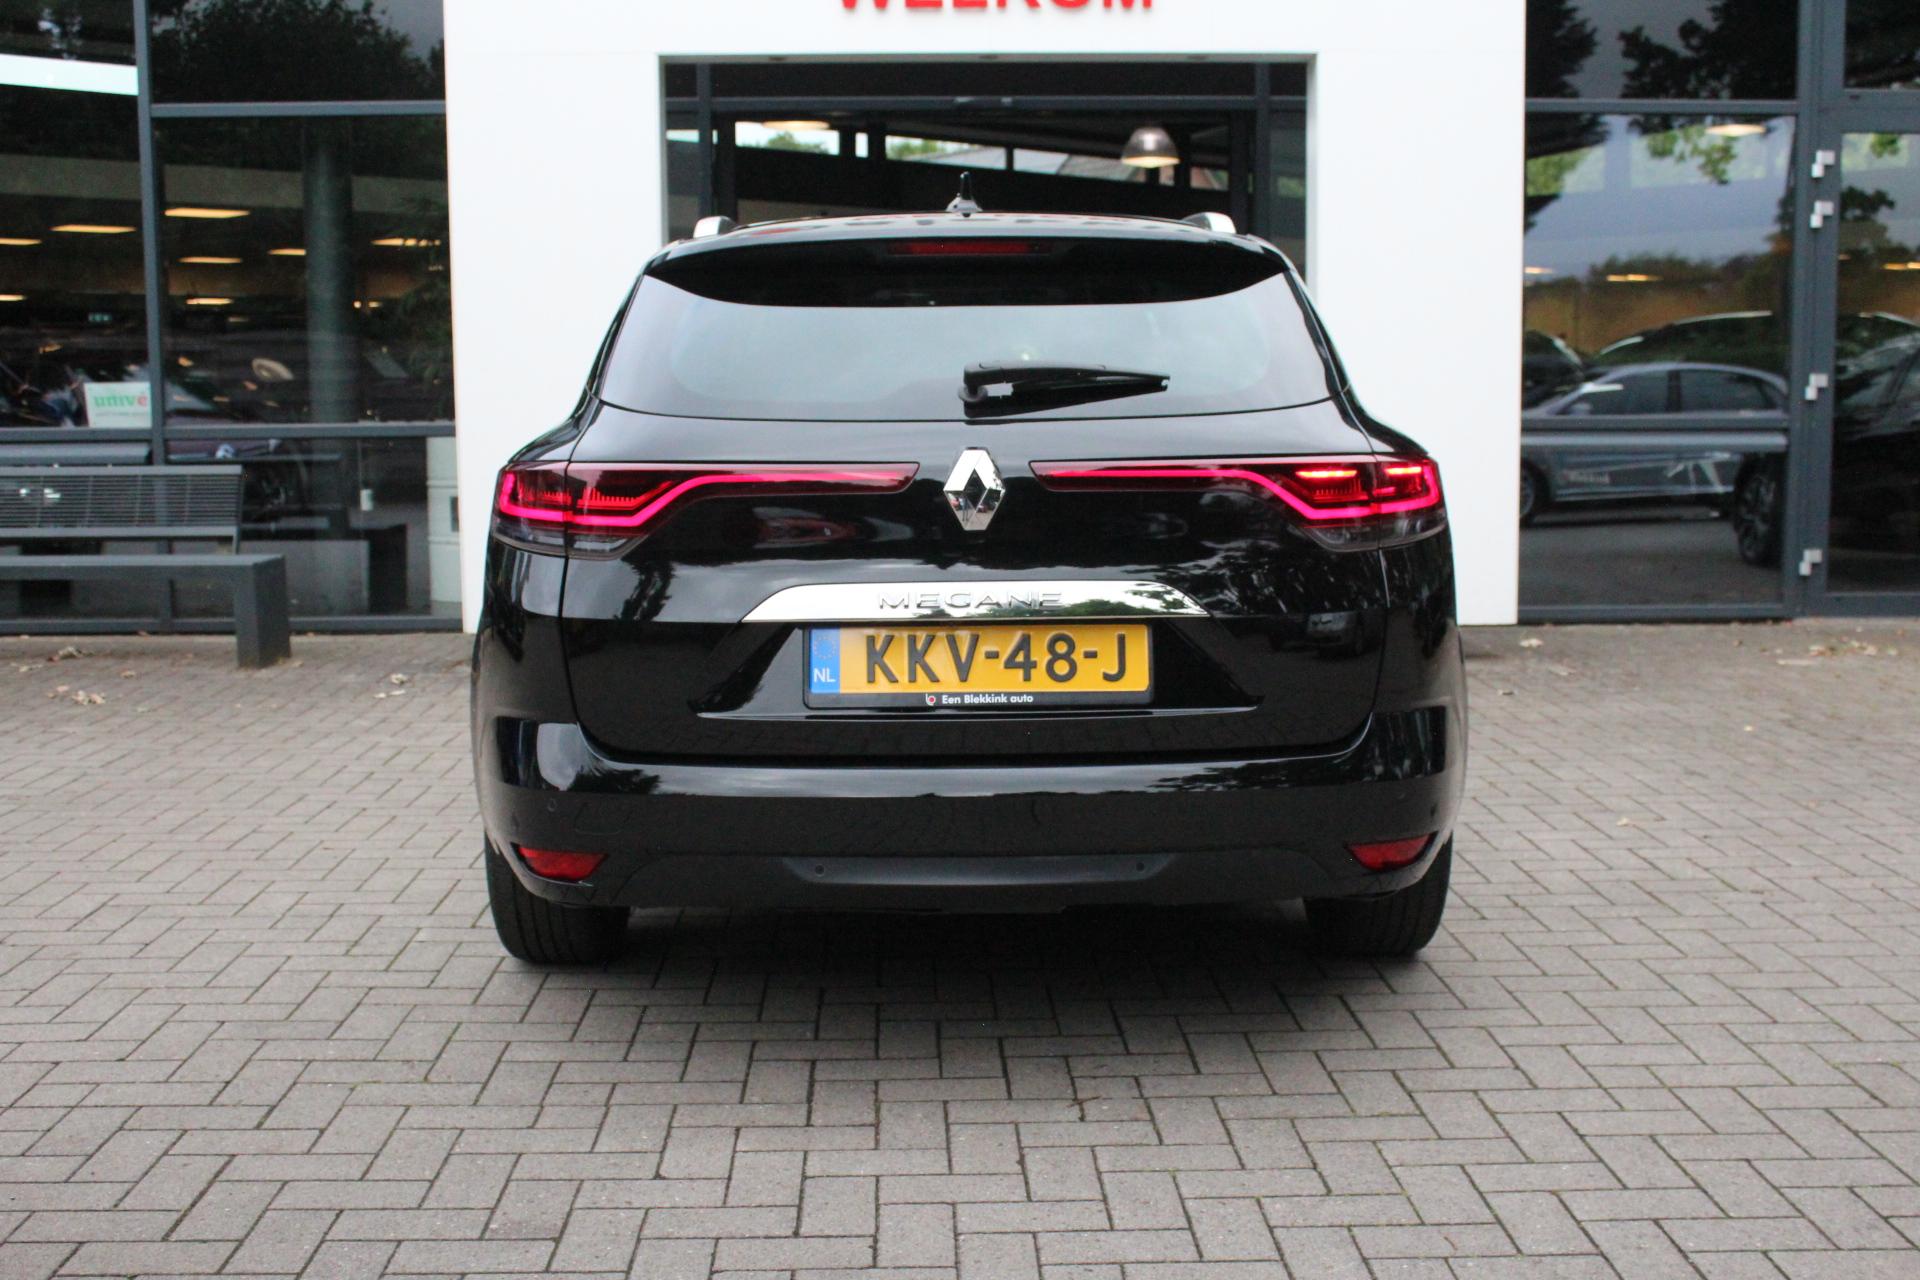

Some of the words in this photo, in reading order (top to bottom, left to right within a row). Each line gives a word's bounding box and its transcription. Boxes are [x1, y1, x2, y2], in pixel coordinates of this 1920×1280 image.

[879, 592, 1062, 609] MEGANE
[866, 632, 1127, 683] KKV-48-J
[813, 668, 835, 683] NL
[942, 695, 961, 705] Een
[964, 693, 1008, 704] Blekkink
[1010, 694, 1034, 703] auto
